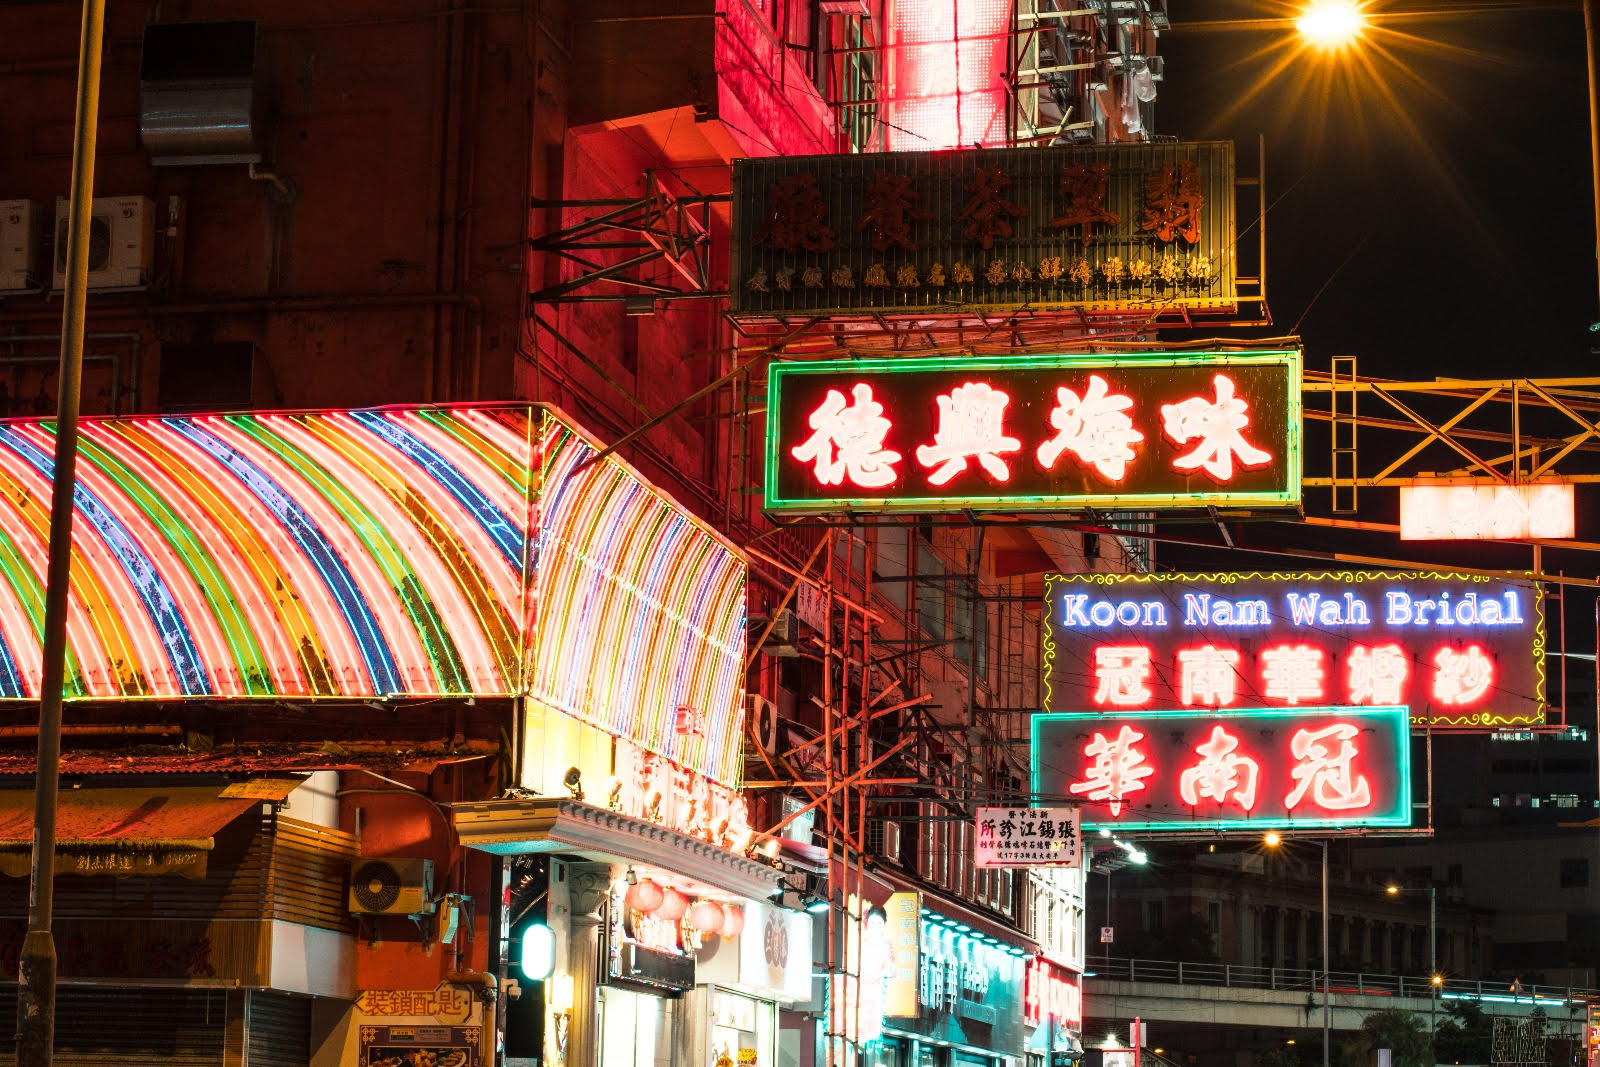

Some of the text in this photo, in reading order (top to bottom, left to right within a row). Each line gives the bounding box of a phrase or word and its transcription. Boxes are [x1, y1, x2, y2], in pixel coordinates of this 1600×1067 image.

[791, 375, 1272, 487] 德興海味
[1063, 590, 1524, 627] Koon Nam Wah Bridal
[1094, 644, 1493, 706] 冠南華婚紗
[1070, 722, 1372, 817] 冠南華
[365, 990, 462, 1017] 裝鎖配匙
